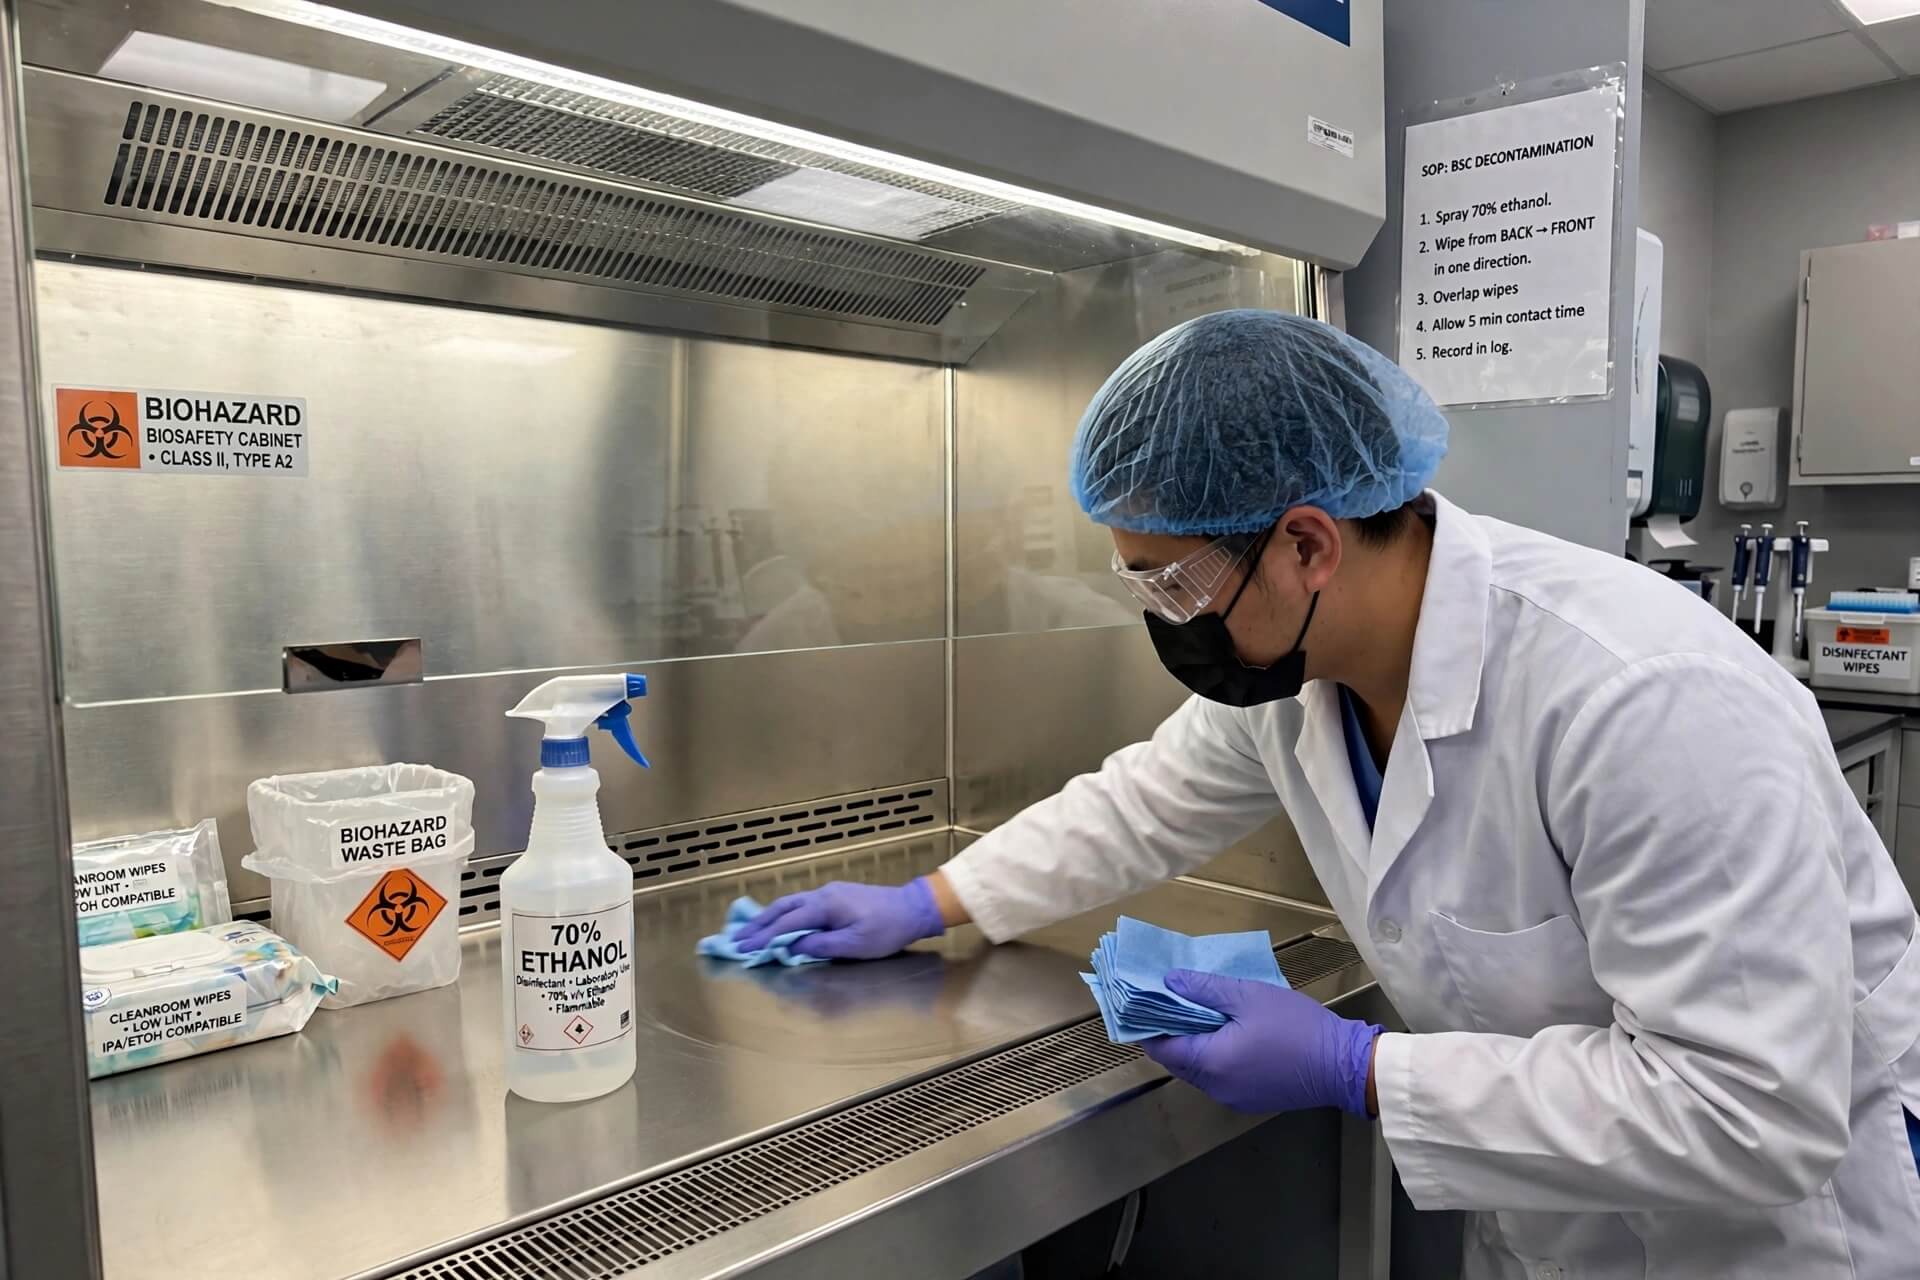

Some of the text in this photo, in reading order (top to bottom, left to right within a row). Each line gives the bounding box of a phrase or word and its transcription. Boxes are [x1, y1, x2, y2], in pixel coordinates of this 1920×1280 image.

[1421, 134, 1594, 177] SOP: BSC DECONTAMINATION
[1420, 192, 1552, 225] 1. Spray 70% ethanol.
[1419, 216, 1596, 254] 2. Wipe from BACK FRONT
[1434, 252, 1532, 276] in one direction.
[1417, 282, 1519, 305] 3. Overlap wipes
[1416, 302, 1585, 333] 4. Allow 5 min contact time
[1416, 339, 1513, 360] 5. Record in log.
[145, 397, 301, 426] BIOHAZARD
[147, 428, 302, 448] BIOSAFETY CABINET
[160, 450, 293, 470] CLASS II, TYPE A2
[1822, 646, 1908, 662] DISINFECTANT
[1843, 661, 1880, 674] WIPES
[341, 816, 447, 844] BIOHAZARD
[341, 834, 447, 863] WASTE BAG
[128, 863, 166, 877] WIPES
[95, 883, 121, 896] LINT
[101, 888, 176, 909] COMPATIBLE
[551, 920, 601, 946] 70%
[521, 940, 627, 973] ETHANOL
[516, 975, 566, 988] Disinfectant
[576, 970, 618, 986] Laboratory
[109, 990, 232, 1025] CLEANROOM WIPES
[548, 991, 568, 1001] 70%
[102, 1012, 243, 1053] IPA/ETOH COMPATIBLE
[132, 1011, 192, 1033] LOW LINT
